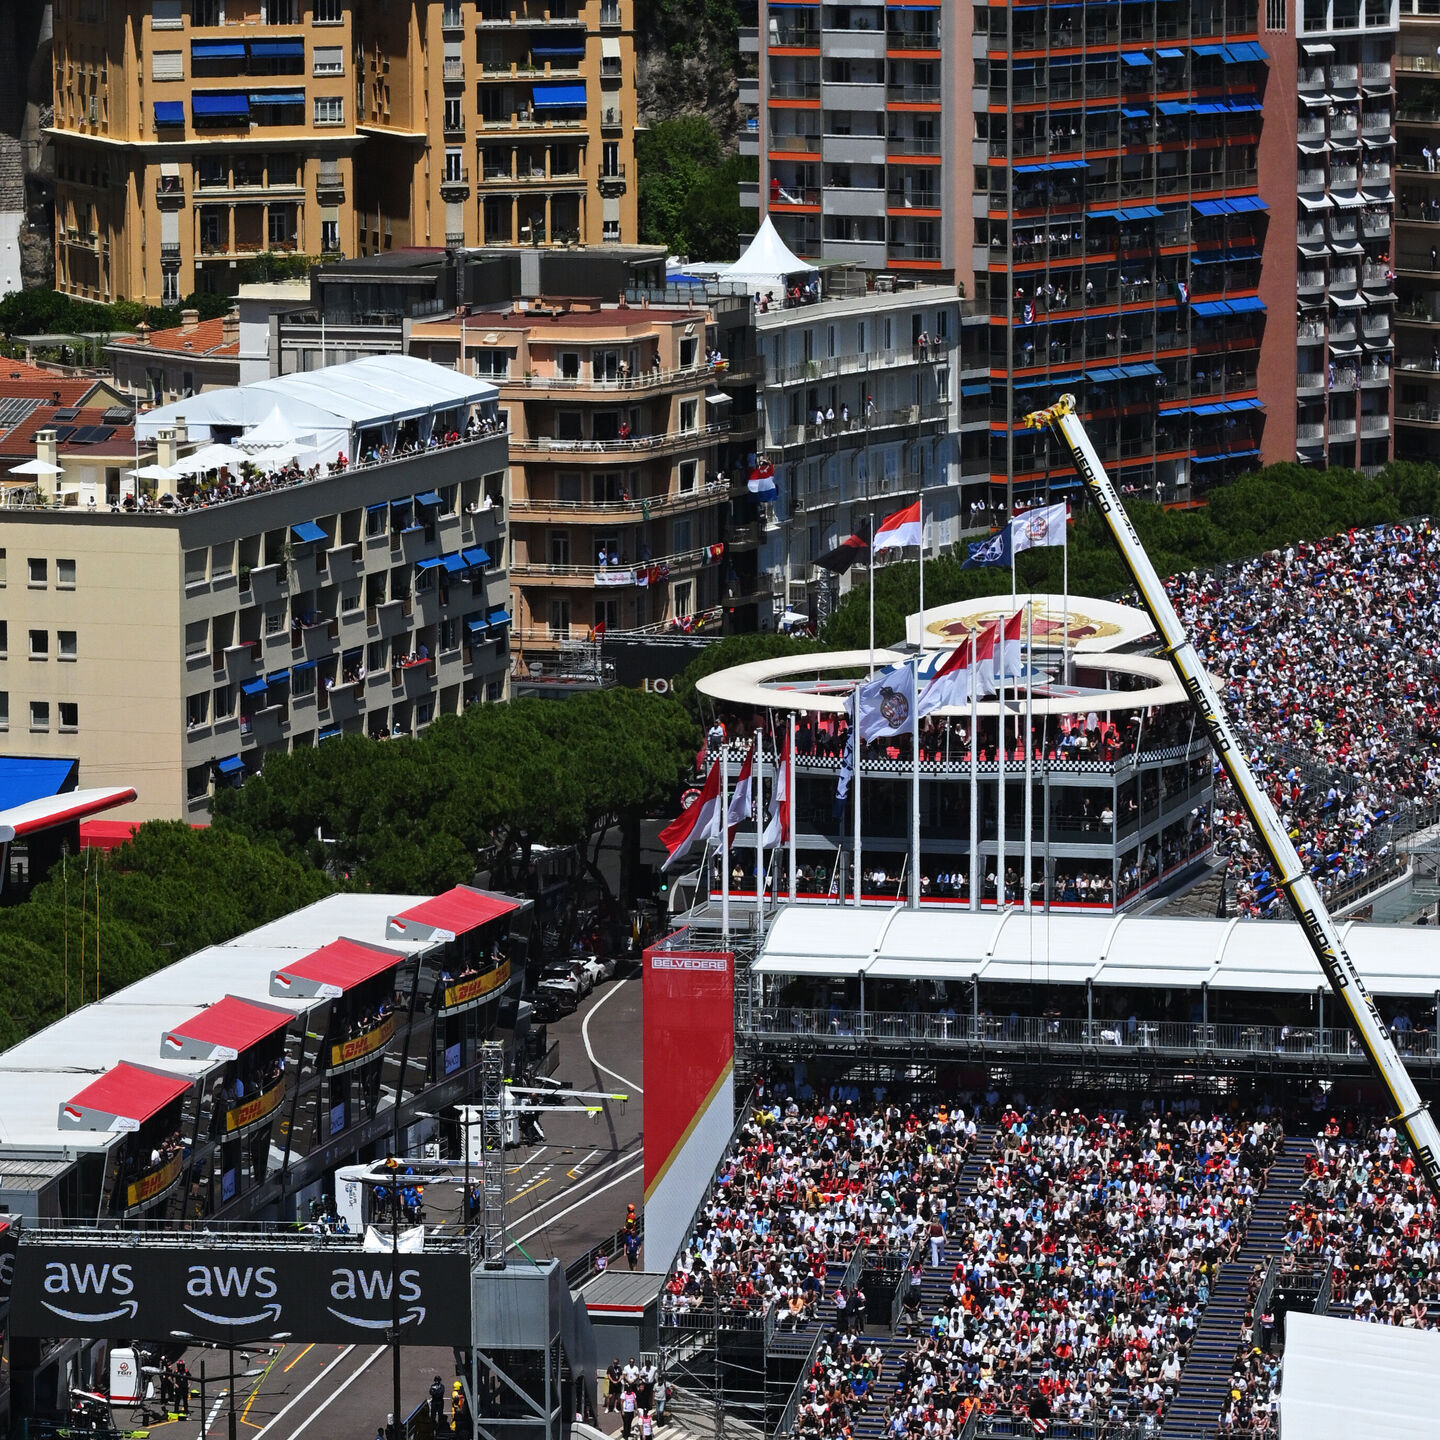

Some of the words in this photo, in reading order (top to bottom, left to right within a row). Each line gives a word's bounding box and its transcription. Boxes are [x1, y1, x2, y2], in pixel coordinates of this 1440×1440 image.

[654, 959, 726, 968] BELVEDERE
[458, 980, 482, 1000] DHL
[344, 1038, 368, 1058] DHL
[44, 1262, 134, 1294] aws
[186, 1265, 278, 1298] aws
[330, 1268, 422, 1301] aws
